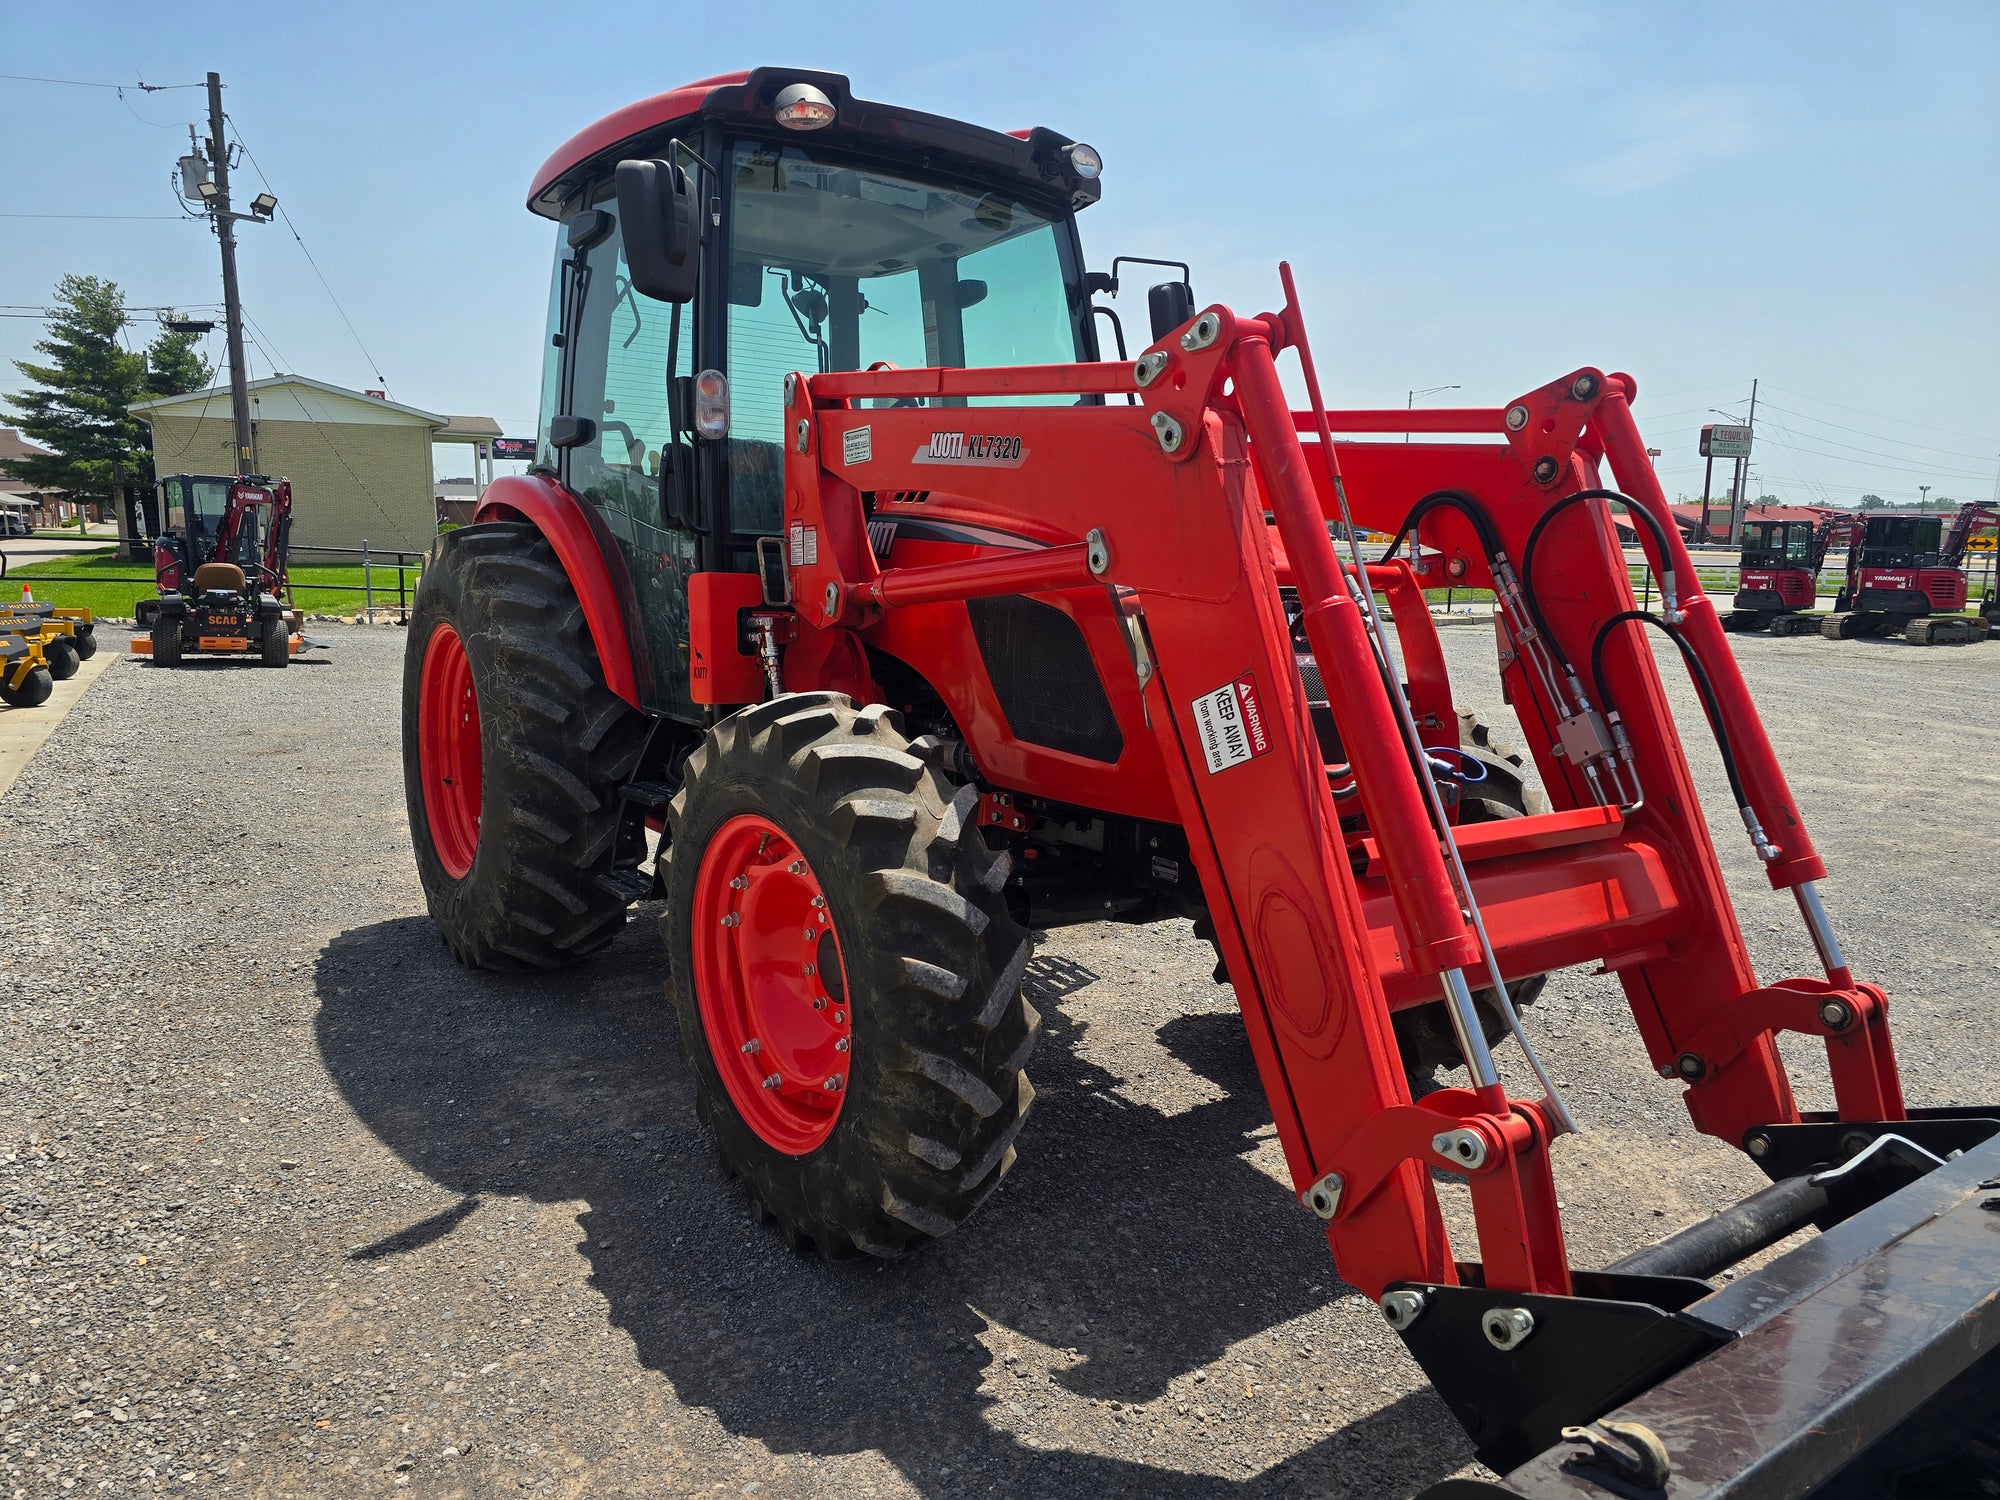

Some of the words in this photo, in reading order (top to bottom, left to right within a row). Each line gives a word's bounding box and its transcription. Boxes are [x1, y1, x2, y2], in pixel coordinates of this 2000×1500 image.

[928, 432, 965, 459] KIOTI
[967, 434, 1022, 461] KL7320
[244, 492, 264, 501] YANMAR
[866, 521, 898, 555] IOTI
[208, 615, 238, 625] SCAG
[693, 666, 708, 679] KIOTI
[1198, 698, 1210, 719] from
[1214, 688, 1236, 721] KEEP
[1203, 718, 1219, 751] working
[1244, 696, 1267, 752] WARNING
[1223, 723, 1246, 759] AWAY
[1212, 750, 1223, 768] area
